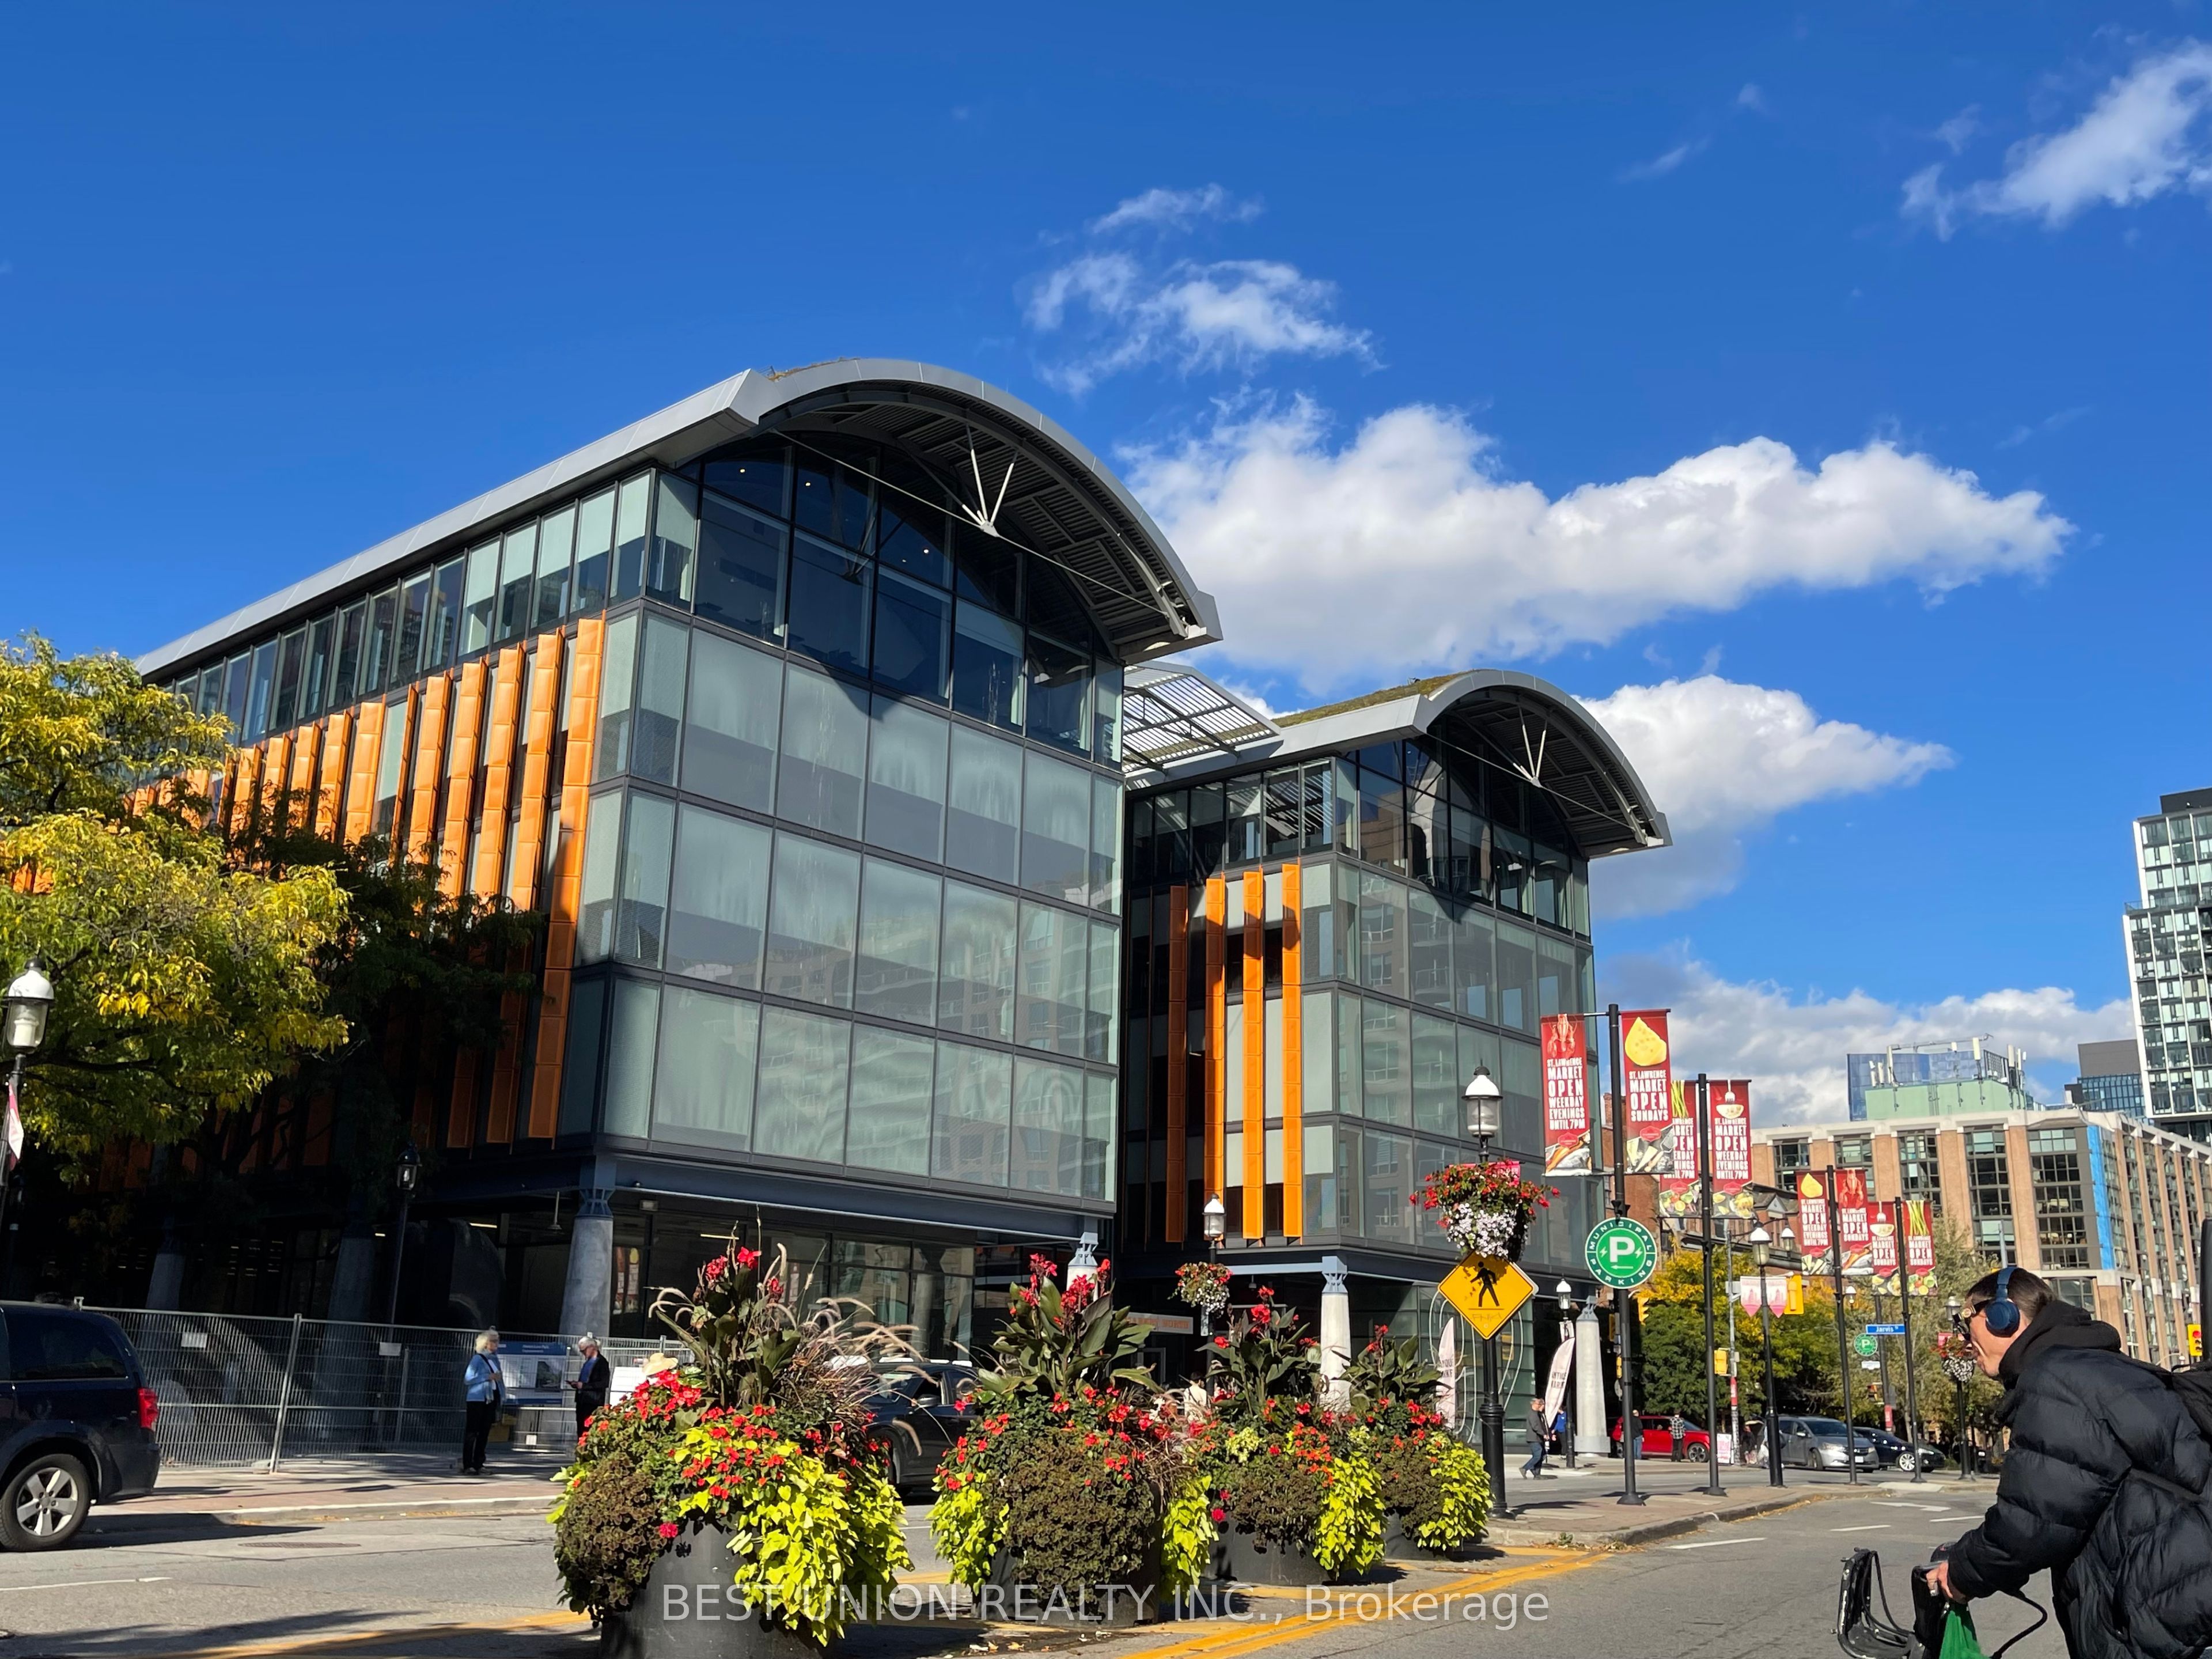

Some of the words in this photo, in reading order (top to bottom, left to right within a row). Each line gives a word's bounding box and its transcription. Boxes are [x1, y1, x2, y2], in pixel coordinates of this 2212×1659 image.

[1547, 1066, 1582, 1080] MARKET
[1629, 1071, 1637, 1080] ST.
[1638, 1070, 1666, 1079] LAWRENCE
[1548, 1079, 1584, 1097] OPEN
[1630, 1079, 1666, 1092] MARKET
[1548, 1096, 1584, 1108] WEEKDAY
[1630, 1092, 1668, 1109] OPEN
[1549, 1107, 1585, 1119] EVENINGS
[1631, 1109, 1668, 1122] SUNDAYS
[1550, 1119, 1569, 1130] UNTIL
[1569, 1118, 1585, 1129] 7PM
[1715, 1125, 1747, 1136] MARKET
[1715, 1136, 1747, 1151] OPEN
[1715, 1150, 1748, 1160] WEEKDAY
[1716, 1160, 1748, 1170] EVENINGS
[1716, 1170, 1734, 1179] UNTIL
[1734, 1170, 1748, 1179] 7PM
[1801, 1205, 1825, 1213] MARKET
[1802, 1213, 1826, 1224] OPEN
[1842, 1214, 1867, 1222] MARKET
[1843, 1222, 1868, 1234] OPEN
[1589, 1221, 1652, 1250] MUNICIPAL
[1843, 1233, 1869, 1242] SUNDAYS
[1609, 1236, 1635, 1263] P
[1873, 1248, 1895, 1259] OPEN
[1910, 1248, 1932, 1259] OPEN
[1590, 1259, 1652, 1285] PARKING
[1861, 1339, 1870, 1349] P
